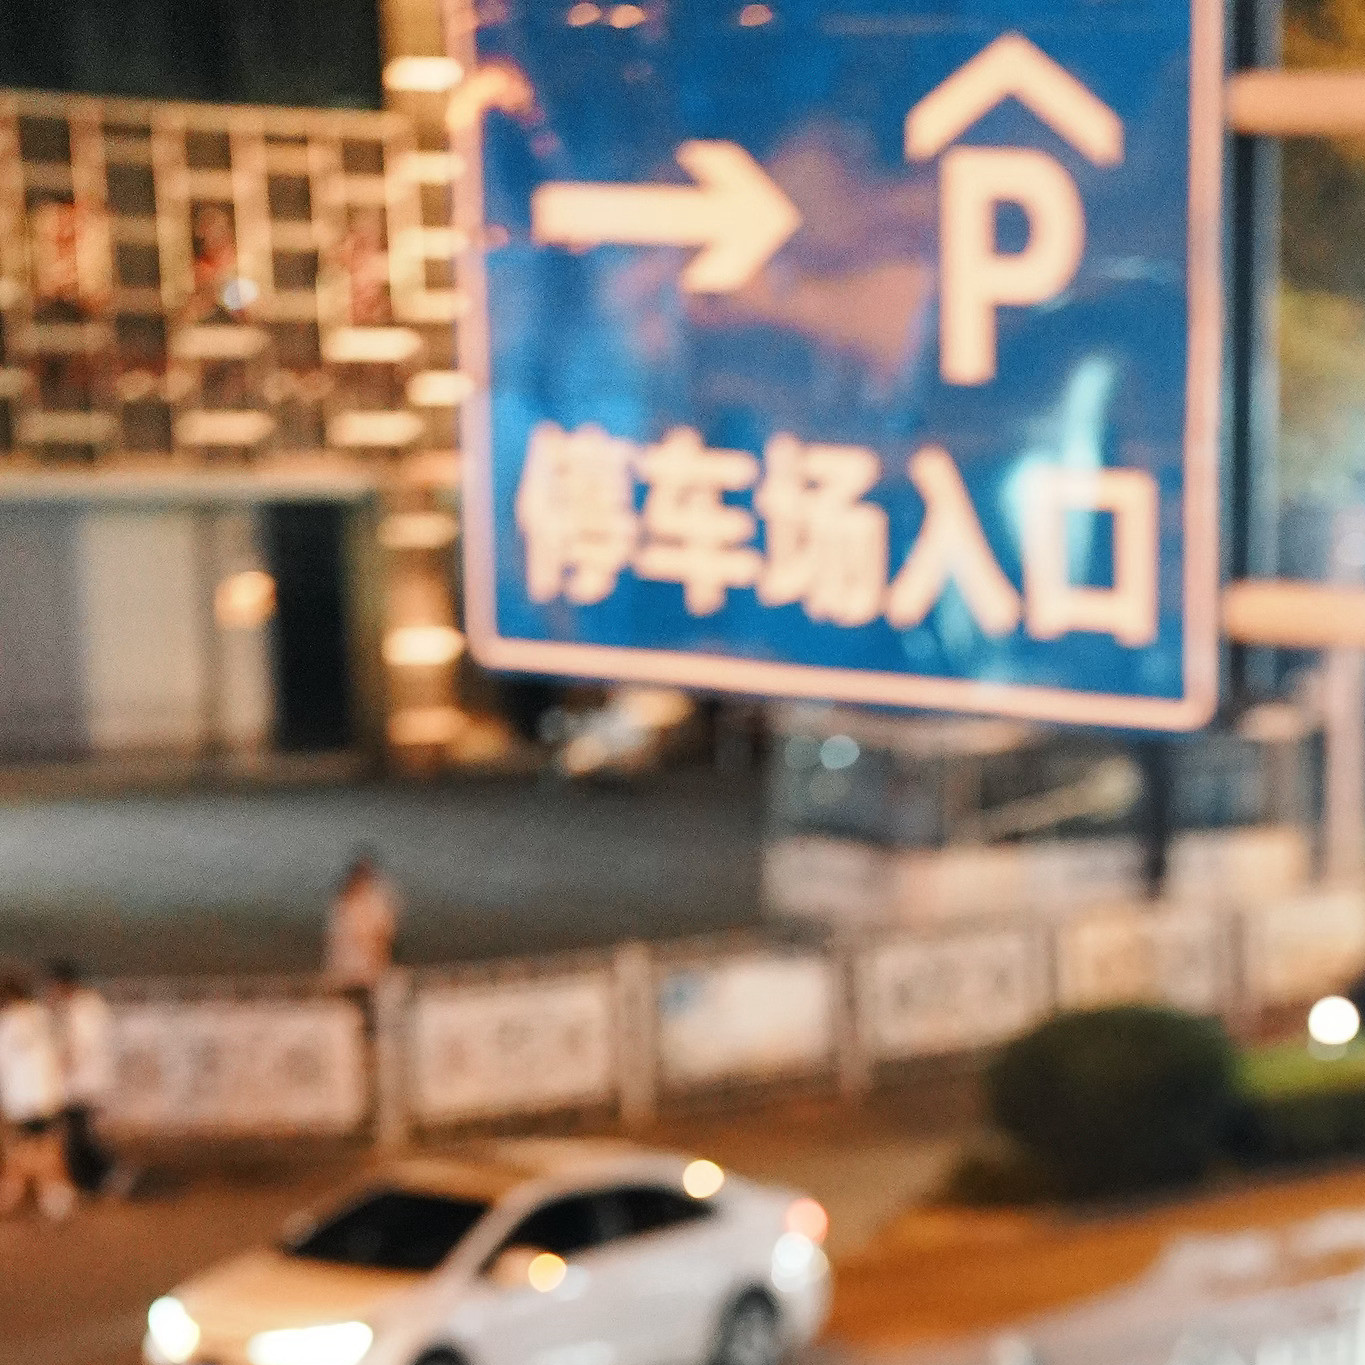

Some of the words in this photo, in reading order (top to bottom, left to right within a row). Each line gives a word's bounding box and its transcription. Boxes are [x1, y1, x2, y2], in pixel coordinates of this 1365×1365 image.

[938, 145, 1087, 387] P
[514, 419, 1161, 648] 停车场入口
